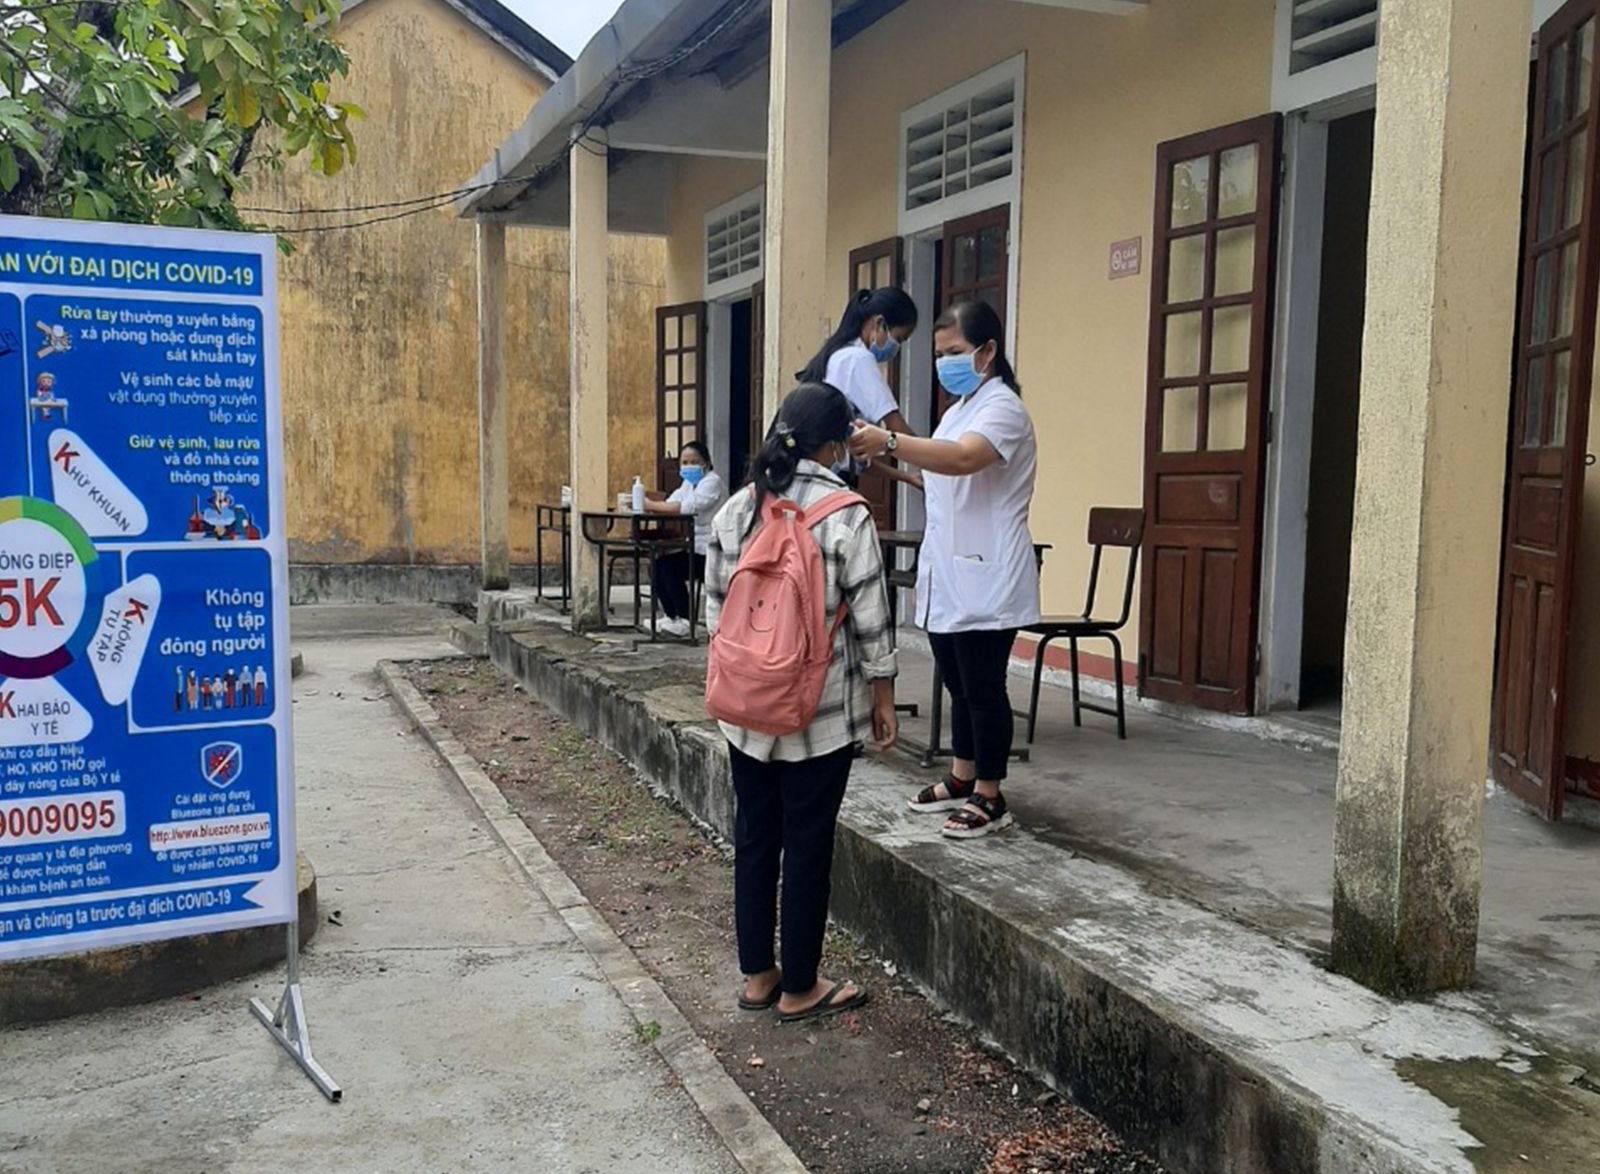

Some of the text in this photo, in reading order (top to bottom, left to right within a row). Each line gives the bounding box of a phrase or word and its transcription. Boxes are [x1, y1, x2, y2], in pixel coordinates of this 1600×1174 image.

[26, 250, 64, 275] VỚI
[70, 256, 105, 281] ĐẠI
[111, 259, 160, 284] DỊCH
[165, 262, 254, 286] COVID-19
[61, 305, 92, 320] Rửa
[96, 308, 118, 324] tay
[120, 309, 173, 328] thường
[177, 313, 218, 329] xuyên
[151, 329, 185, 346] hoặc
[188, 331, 224, 348] dung
[227, 332, 256, 349] dịch
[236, 351, 256, 367] tay
[120, 371, 139, 388] Vệ
[143, 374, 173, 387] sinh
[132, 390, 166, 407] dụng
[158, 434, 175, 451] vệ
[214, 437, 234, 449] lau
[38, 551, 75, 573] ĐIỆP
[0, 577, 64, 628] 5K
[206, 588, 264, 608] Không
[215, 610, 265, 632] tụ tập
[160, 633, 266, 657] đông người
[31, 722, 39, 735] Y
[100, 772, 108, 784] Y
[216, 853, 259, 868] COVID-19
[34, 909, 74, 930] chúng
[76, 908, 88, 924] ta
[91, 902, 125, 922] trước
[128, 899, 147, 920] đại
[148, 896, 175, 918] dịch
[176, 888, 233, 911] COVID-19
